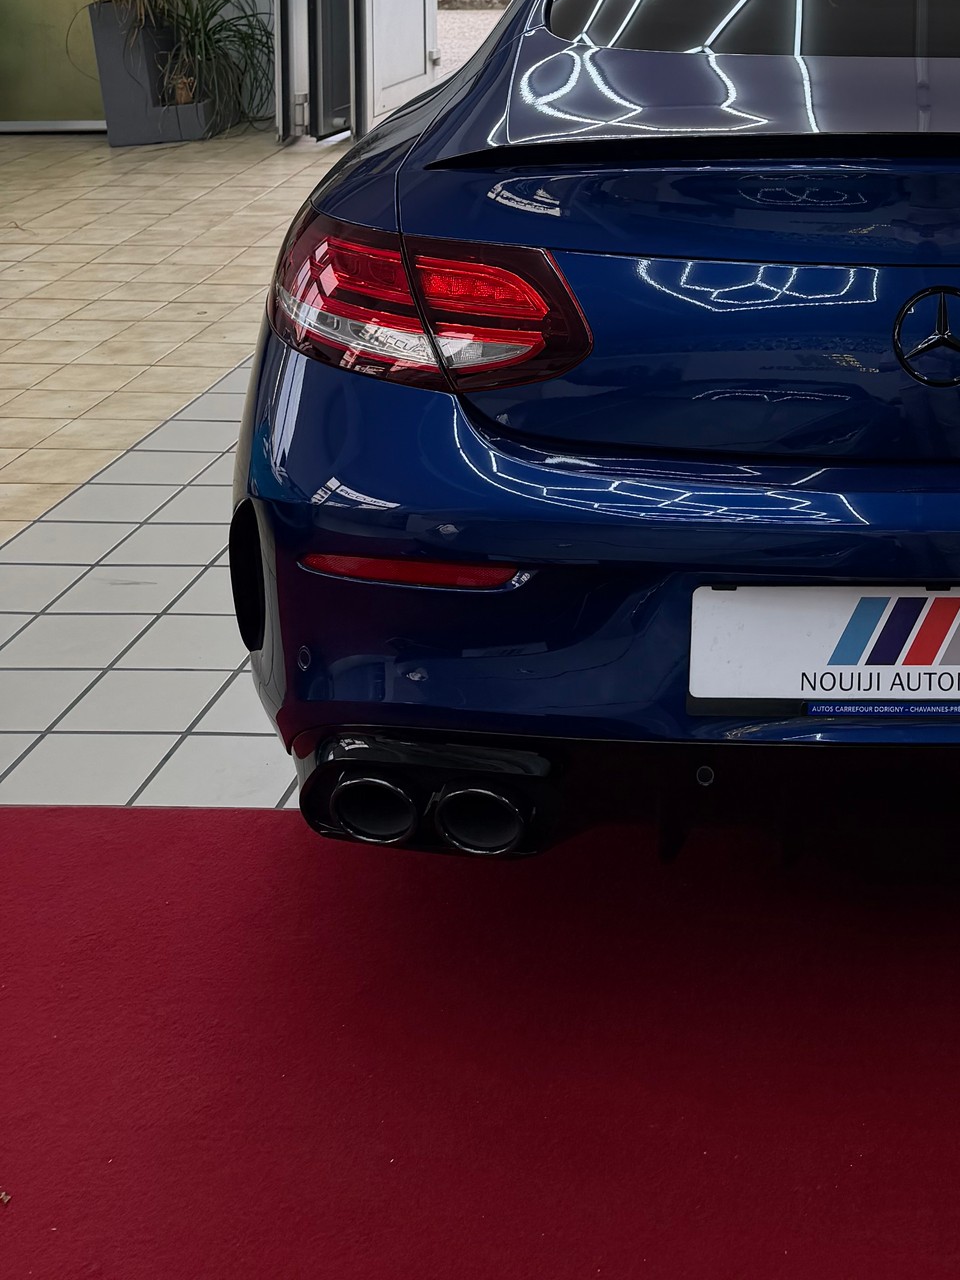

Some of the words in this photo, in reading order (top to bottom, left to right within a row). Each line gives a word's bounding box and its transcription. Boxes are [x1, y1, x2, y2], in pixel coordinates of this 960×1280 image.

[800, 672, 881, 692] NOUIJI
[811, 705, 834, 713] AUTOS
[834, 705, 873, 713] CARREFOUR
[874, 705, 904, 713] DORIGNY
